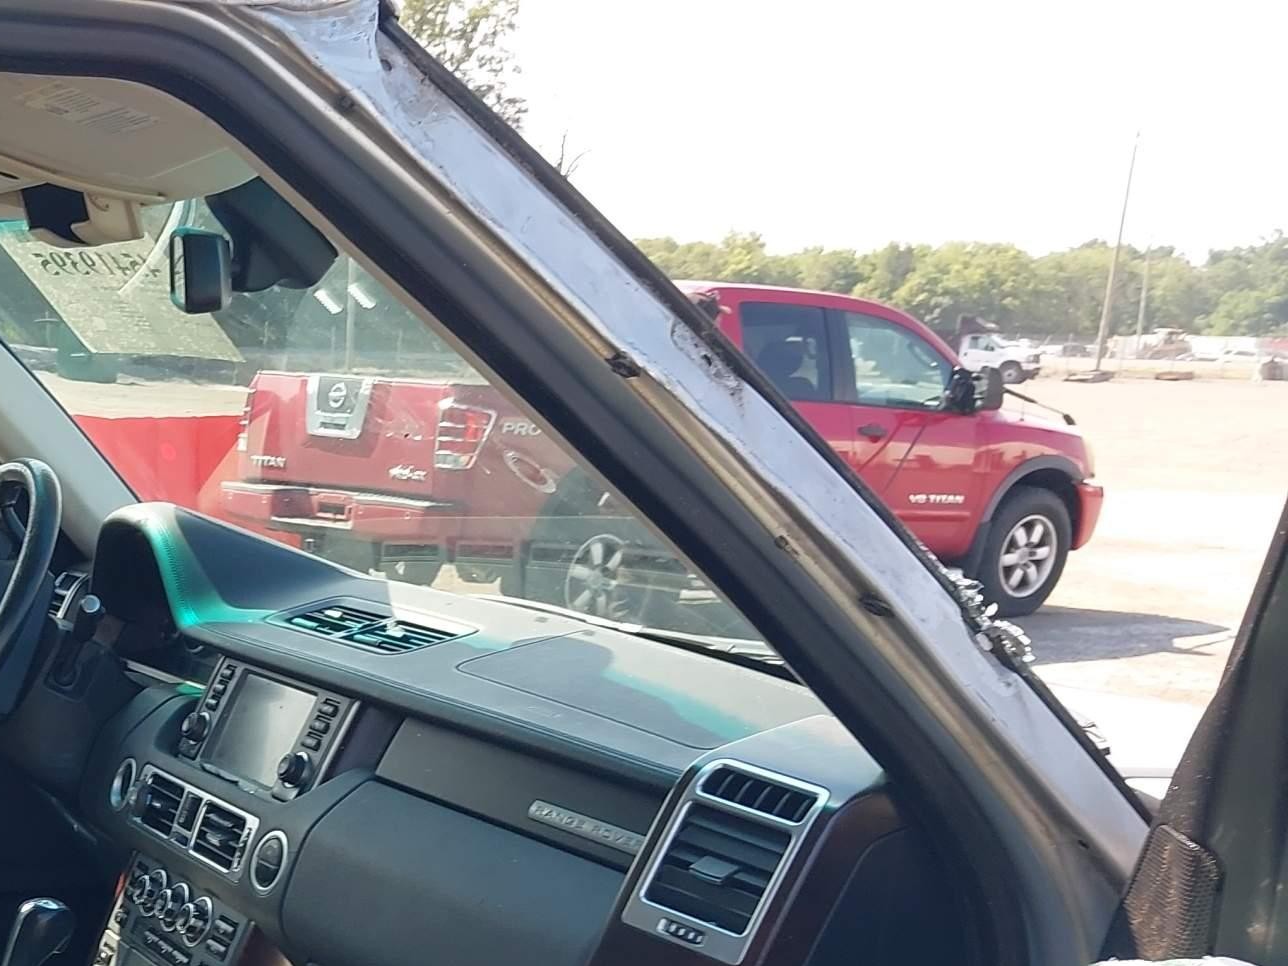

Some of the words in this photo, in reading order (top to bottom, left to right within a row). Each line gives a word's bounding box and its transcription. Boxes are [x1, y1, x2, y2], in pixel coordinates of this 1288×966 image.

[249, 455, 287, 468] TITAN
[928, 493, 966, 504] TITAN
[534, 803, 586, 831] RANGE
